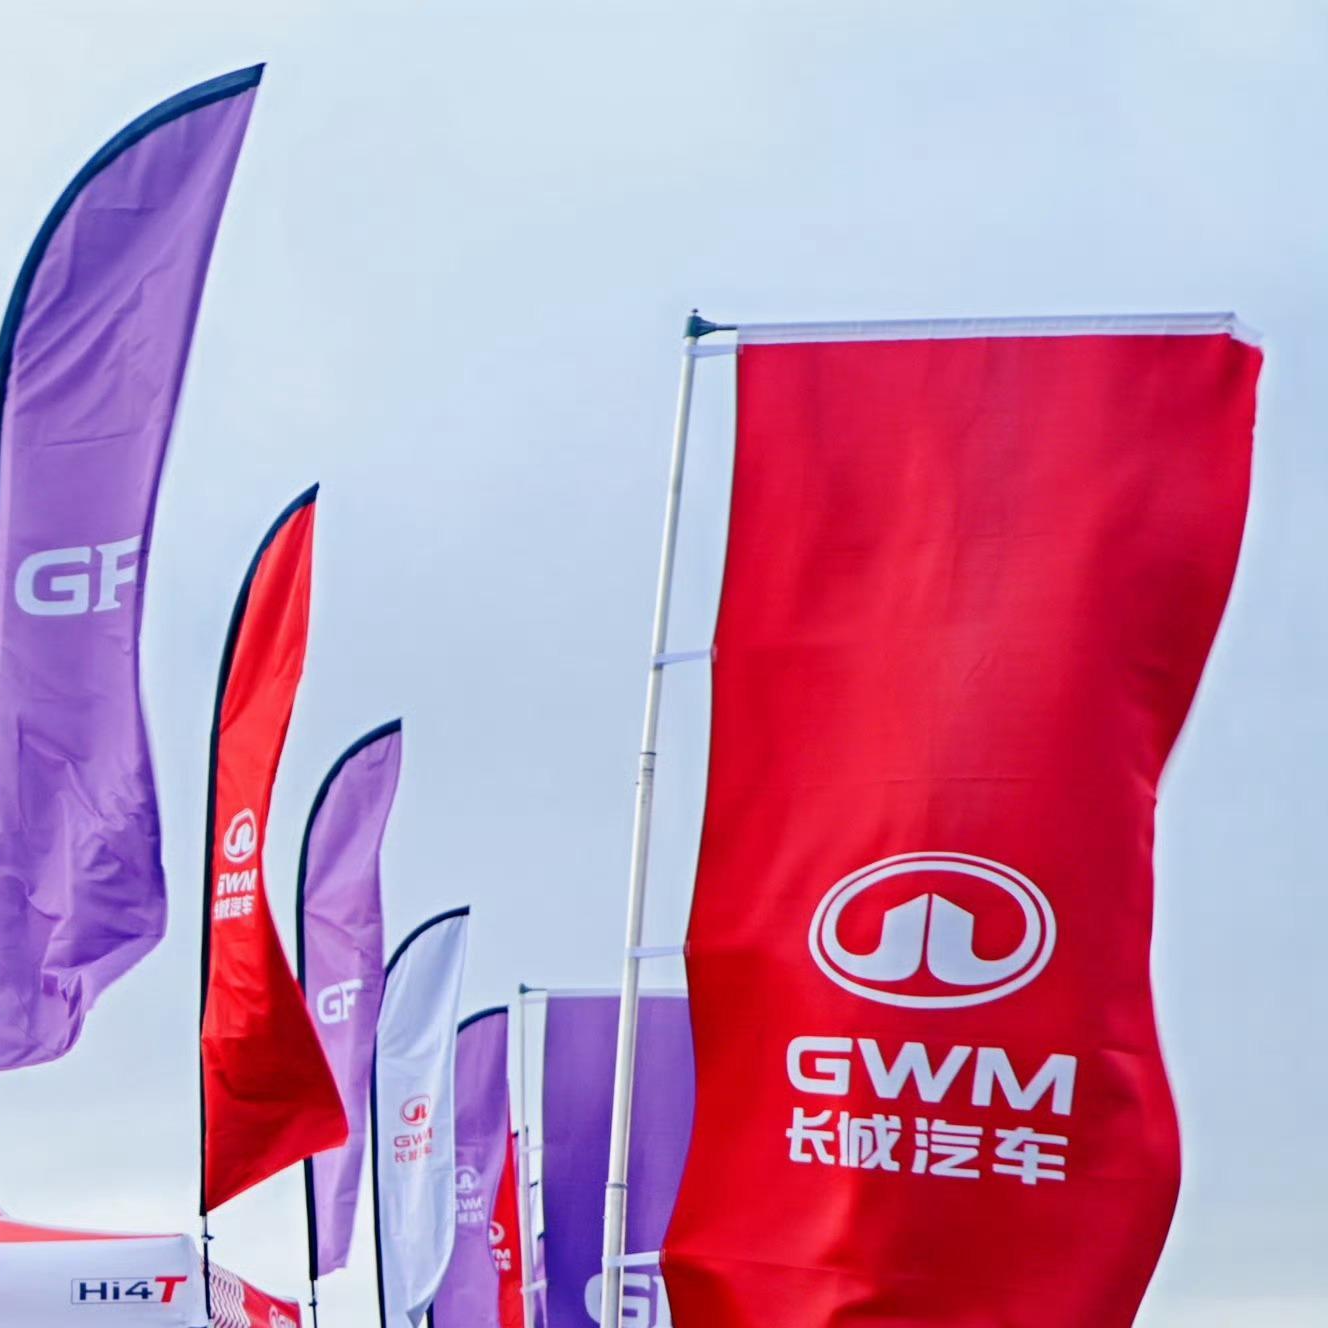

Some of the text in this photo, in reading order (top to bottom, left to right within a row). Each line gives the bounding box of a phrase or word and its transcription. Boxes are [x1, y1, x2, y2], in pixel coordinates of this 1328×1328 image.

[15, 535, 143, 617] GF
[316, 978, 363, 1025] GF
[786, 1035, 1077, 1117] GWM
[785, 1107, 1069, 1185] 长城汽车
[77, 1275, 188, 1304] Hi4T
